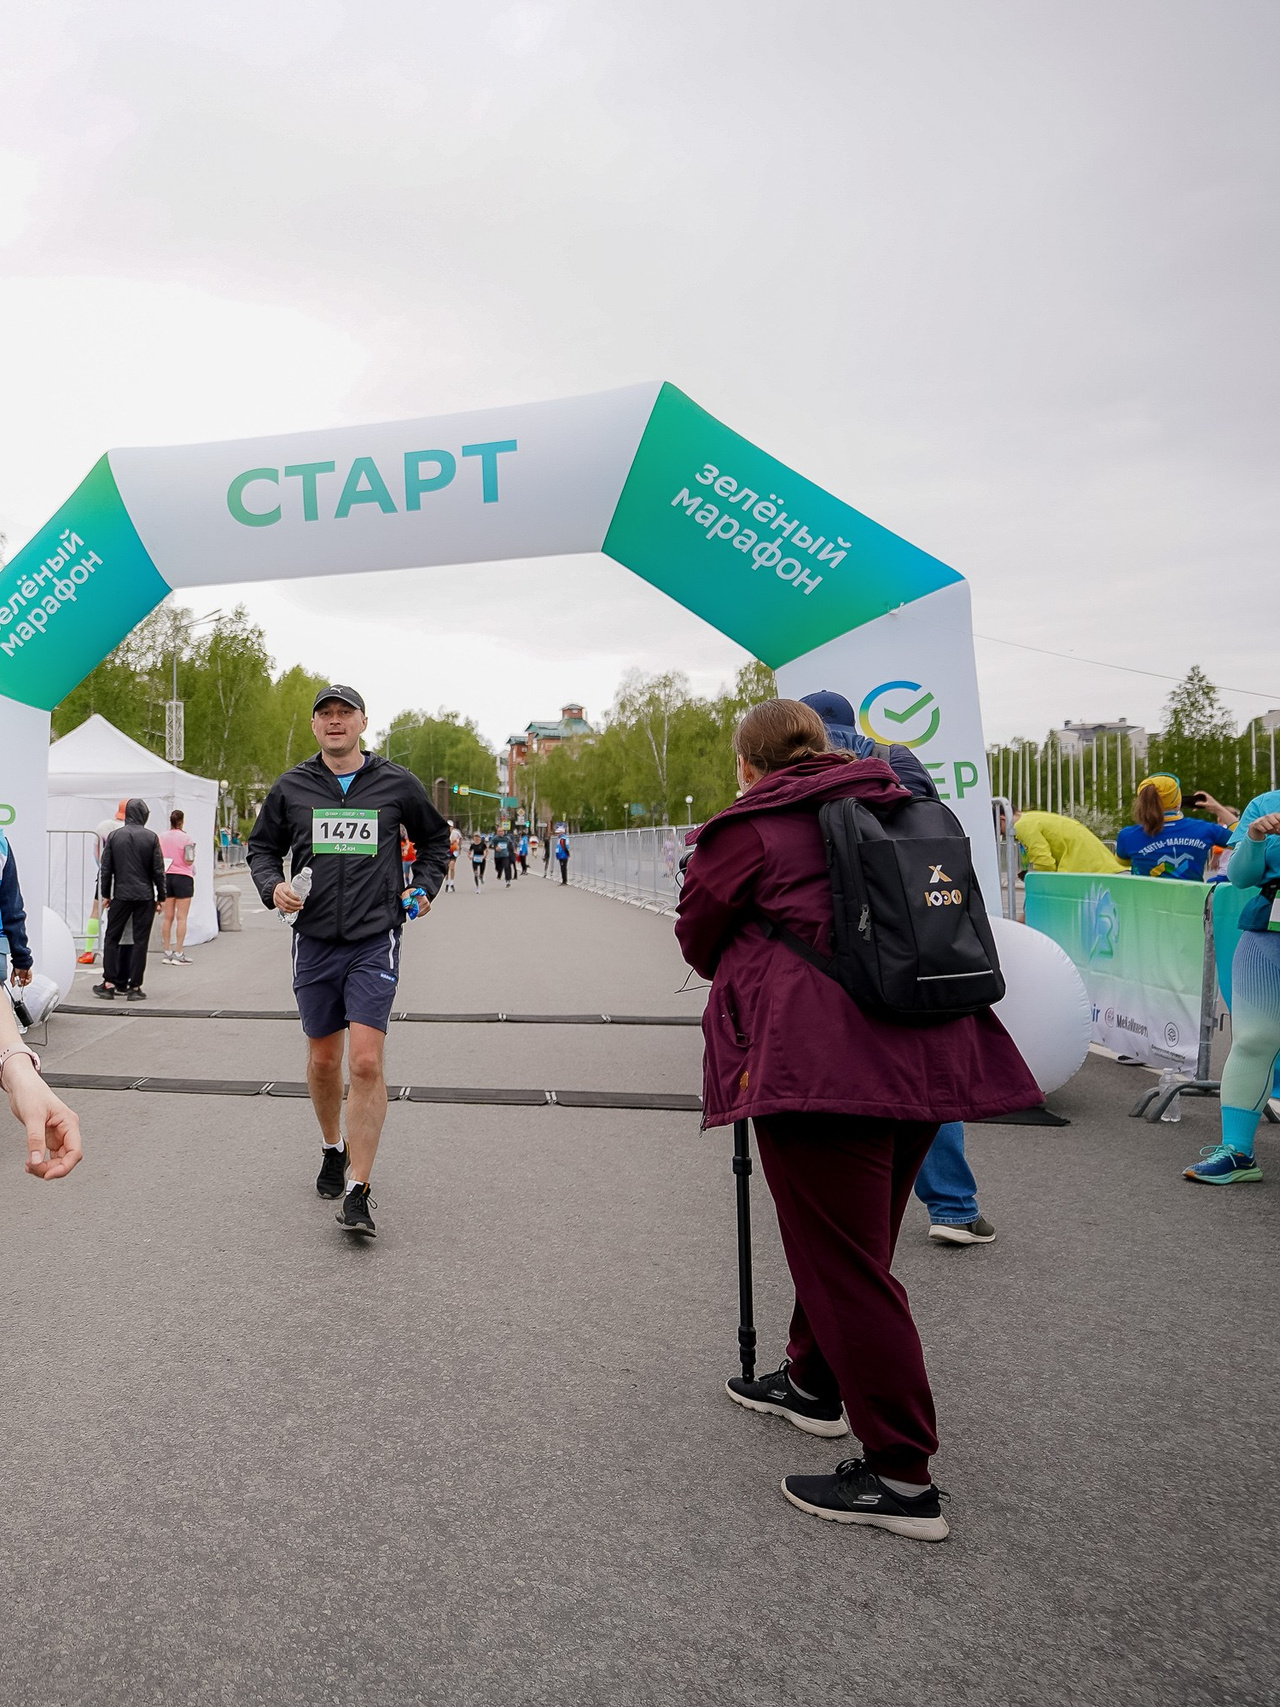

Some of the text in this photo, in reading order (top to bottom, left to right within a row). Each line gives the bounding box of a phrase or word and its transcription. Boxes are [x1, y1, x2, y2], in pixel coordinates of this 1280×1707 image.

[227, 440, 517, 527] СТАРТ
[695, 463, 852, 569] зелёный
[670, 487, 823, 596] марафон
[0, 550, 103, 657] марафон
[320, 822, 371, 840] 1476
